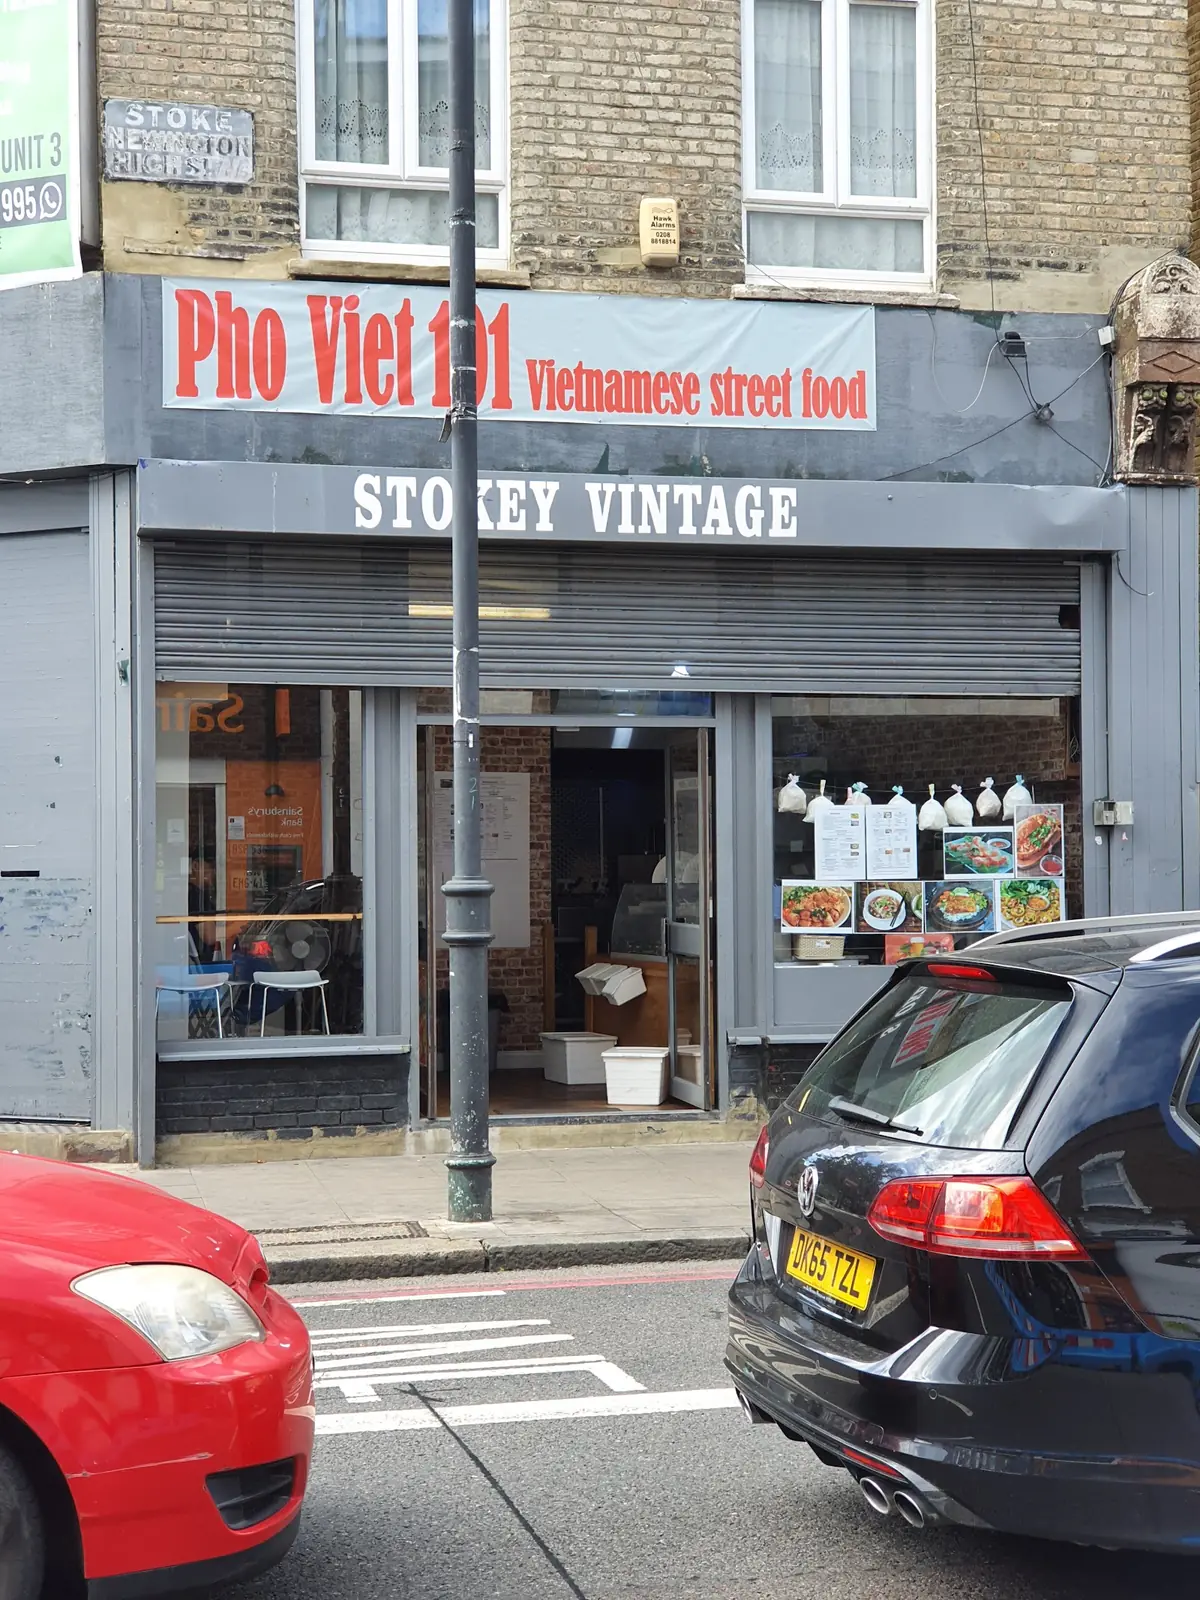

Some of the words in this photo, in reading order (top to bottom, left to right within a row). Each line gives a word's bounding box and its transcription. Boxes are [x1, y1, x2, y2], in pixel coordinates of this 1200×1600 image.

[125, 103, 232, 132] STOKE
[1, 134, 44, 174] UNIT
[50, 131, 62, 167] 3
[1, 185, 37, 222] 995
[175, 289, 287, 401] Pho
[307, 294, 415, 406] Viet
[526, 359, 701, 416] Vietnamese
[710, 366, 793, 418] street
[801, 367, 868, 420] food
[585, 482, 798, 538] VINTAGE
[792, 1234, 831, 1281] DK65
[831, 1251, 860, 1298] TZL
